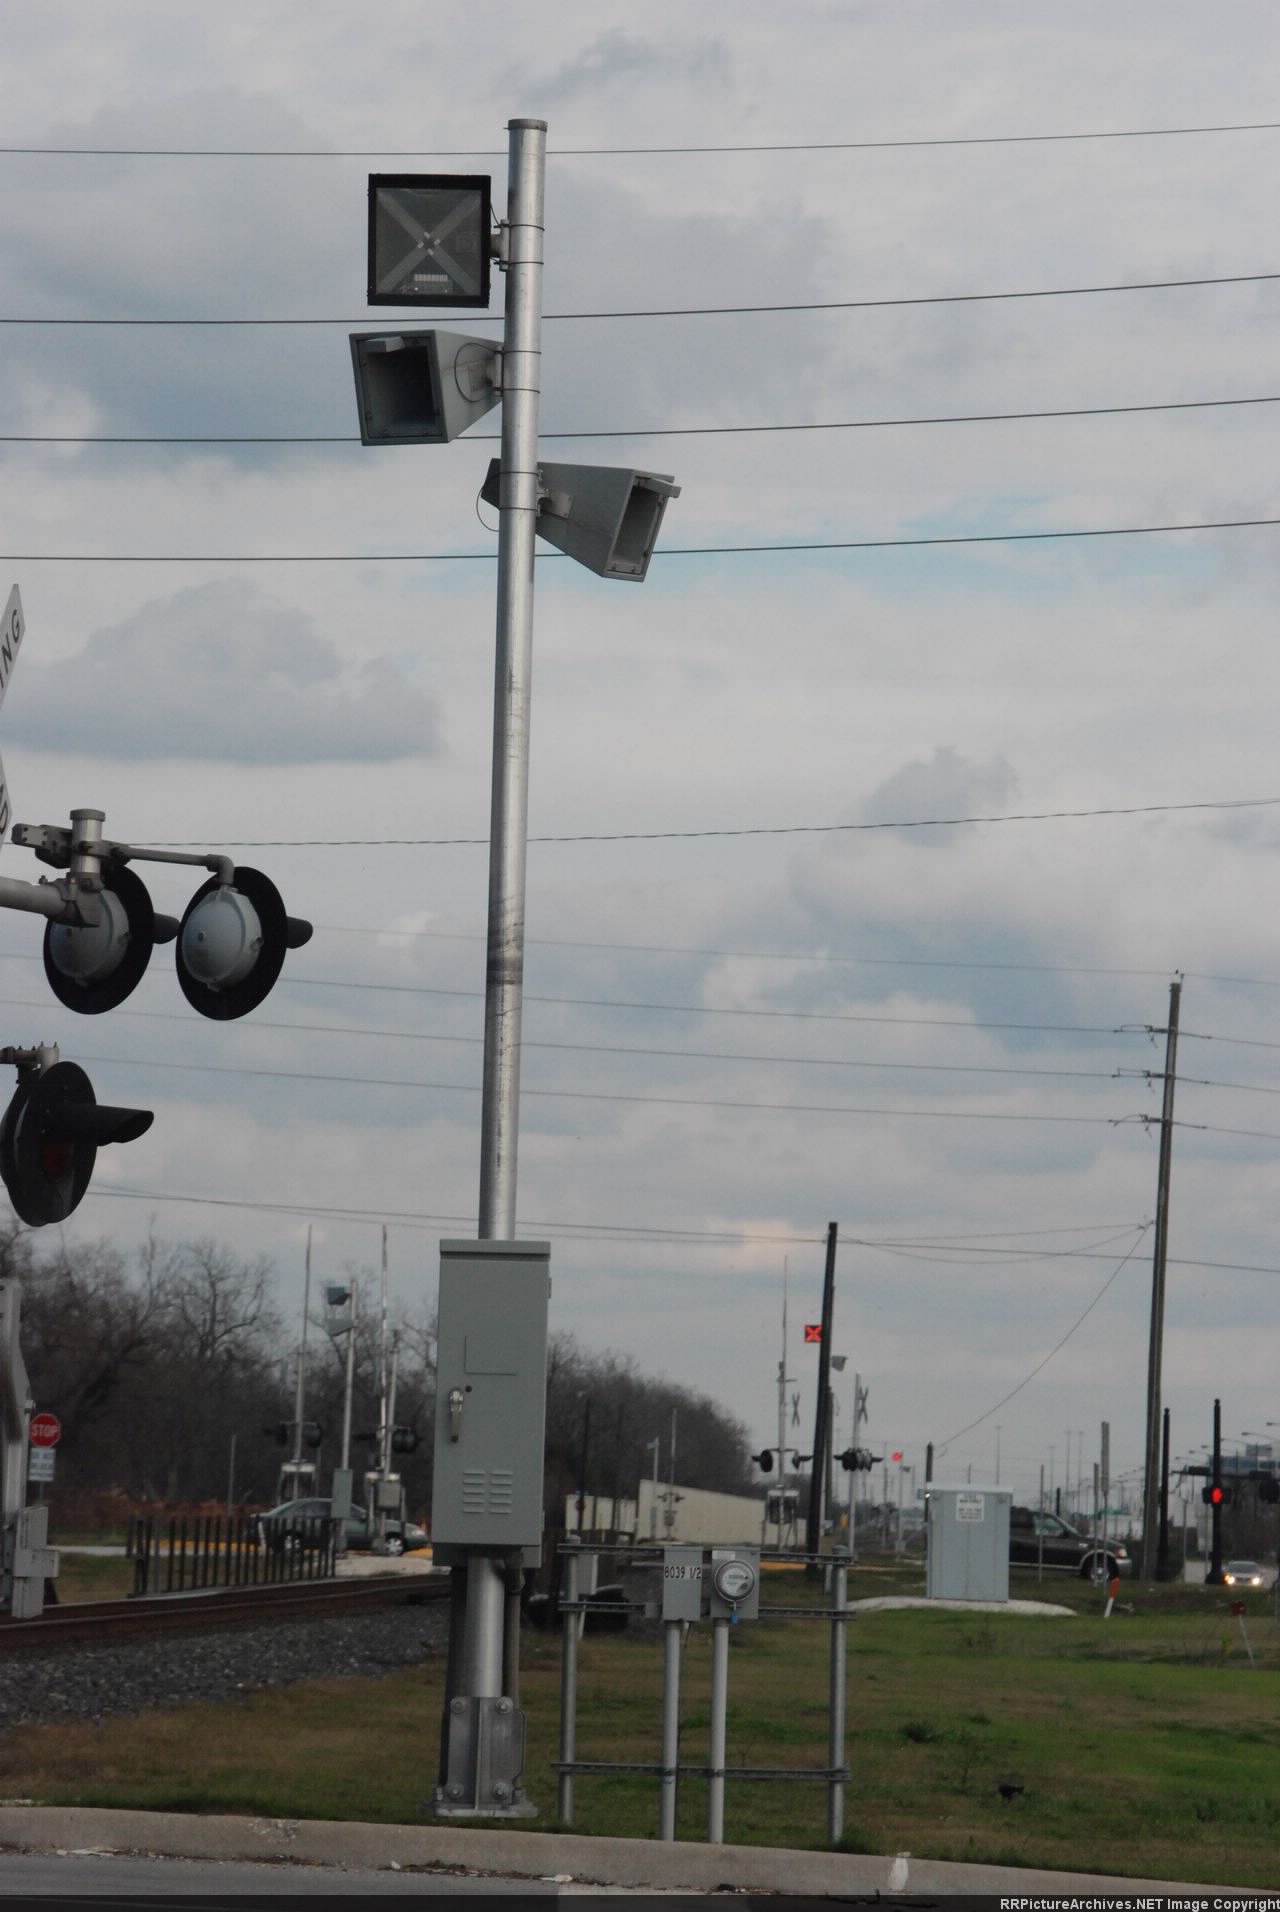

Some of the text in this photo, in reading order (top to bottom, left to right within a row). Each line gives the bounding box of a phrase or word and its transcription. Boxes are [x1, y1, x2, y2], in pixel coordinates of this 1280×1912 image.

[32, 1424, 59, 1437] STOP
[664, 1566, 702, 1579] 8039 1/2
